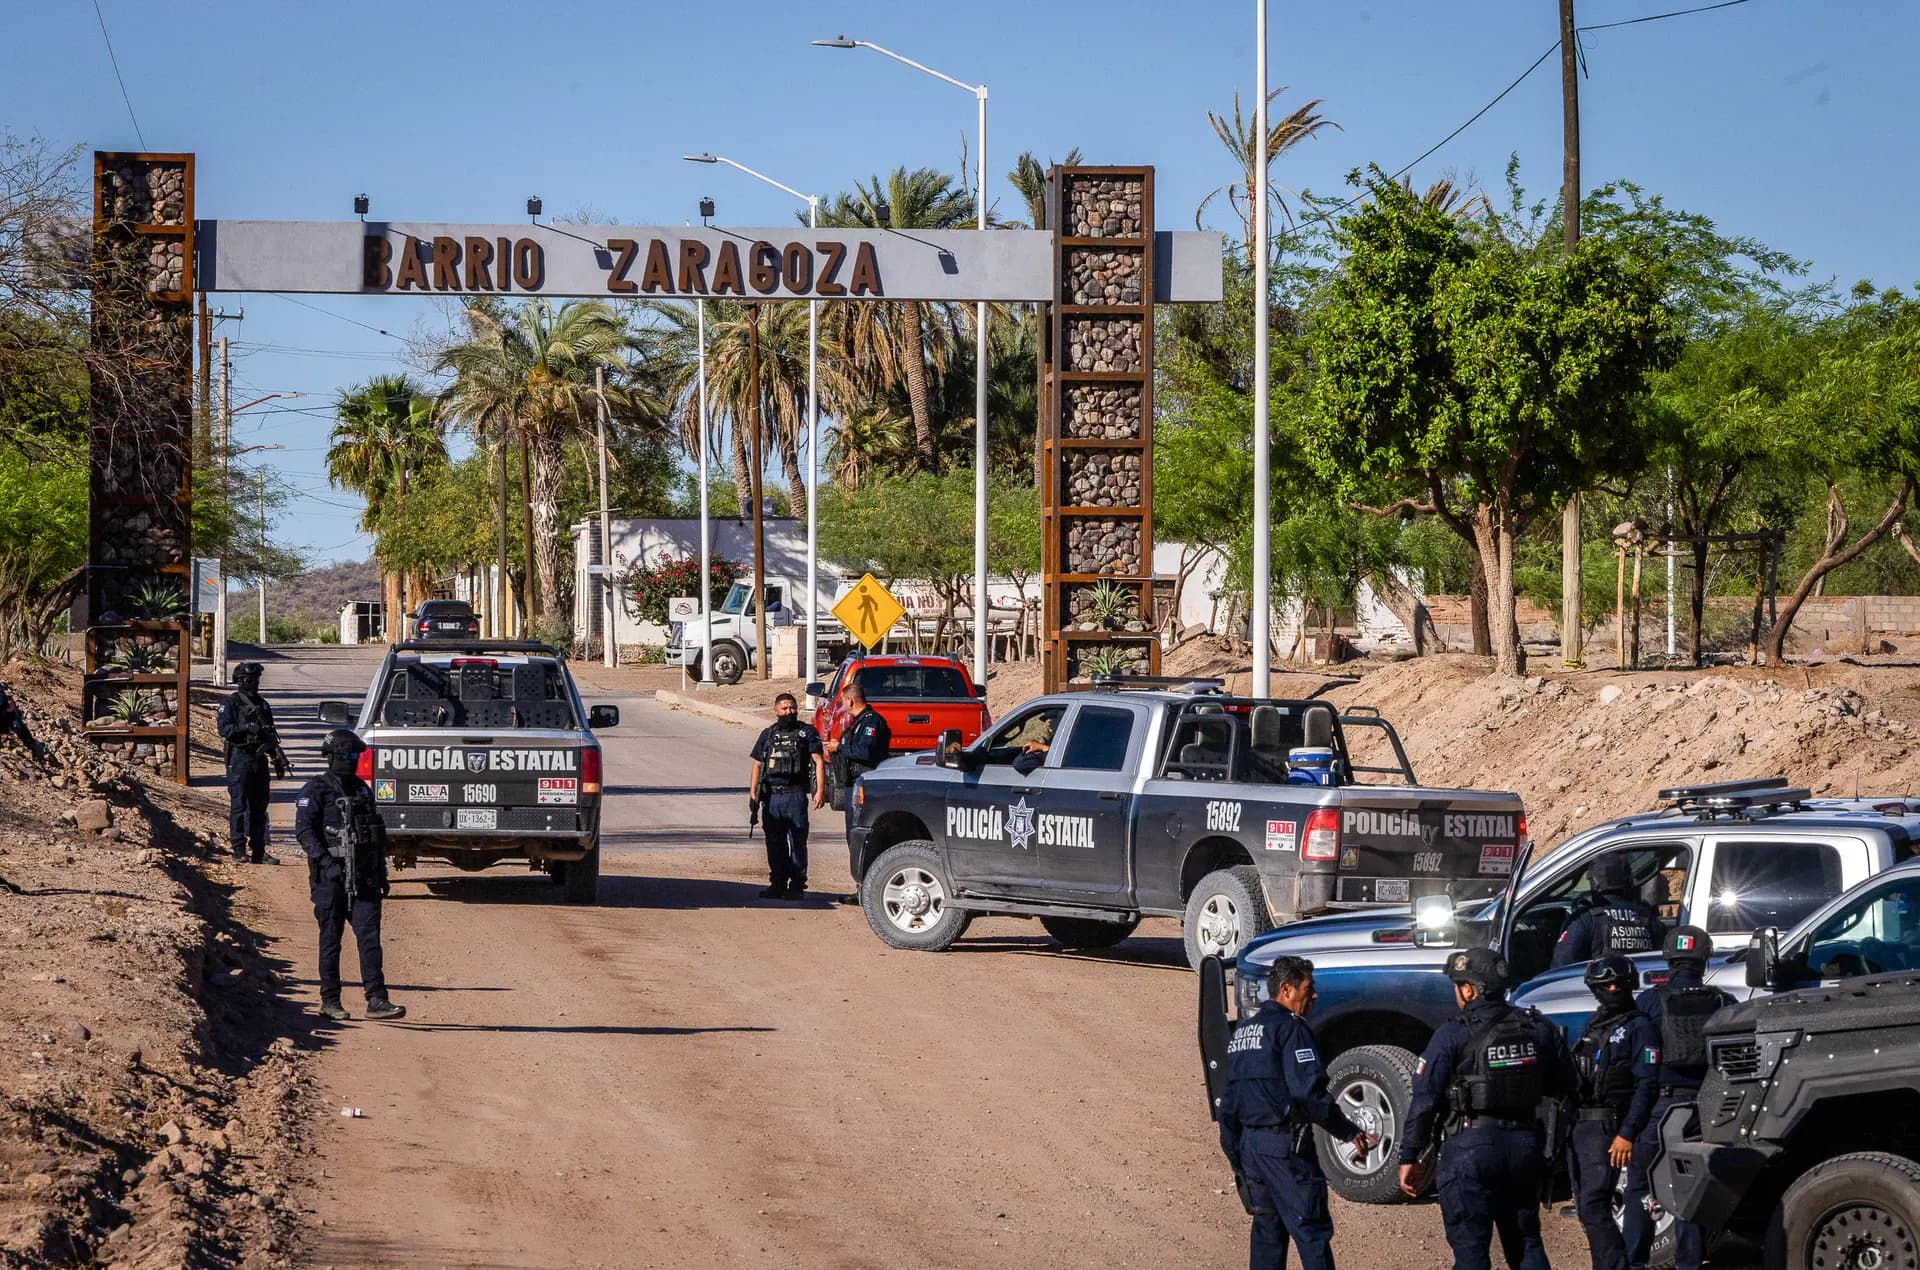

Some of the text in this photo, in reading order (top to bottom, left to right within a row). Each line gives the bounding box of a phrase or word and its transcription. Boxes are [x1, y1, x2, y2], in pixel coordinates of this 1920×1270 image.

[364, 236, 883, 296] BARRIO ZARAGOZA
[377, 746, 577, 771] POLICÍA ESTATAL
[462, 784, 497, 803] 15690
[946, 805, 1095, 849] POLICÍA ESTATAL
[1205, 800, 1242, 832] 15892
[1269, 823, 1292, 833] 911
[1343, 810, 1516, 838] POLICÍA ESTATAL
[1412, 852, 1444, 872] 15892
[1484, 847, 1509, 857] 911
